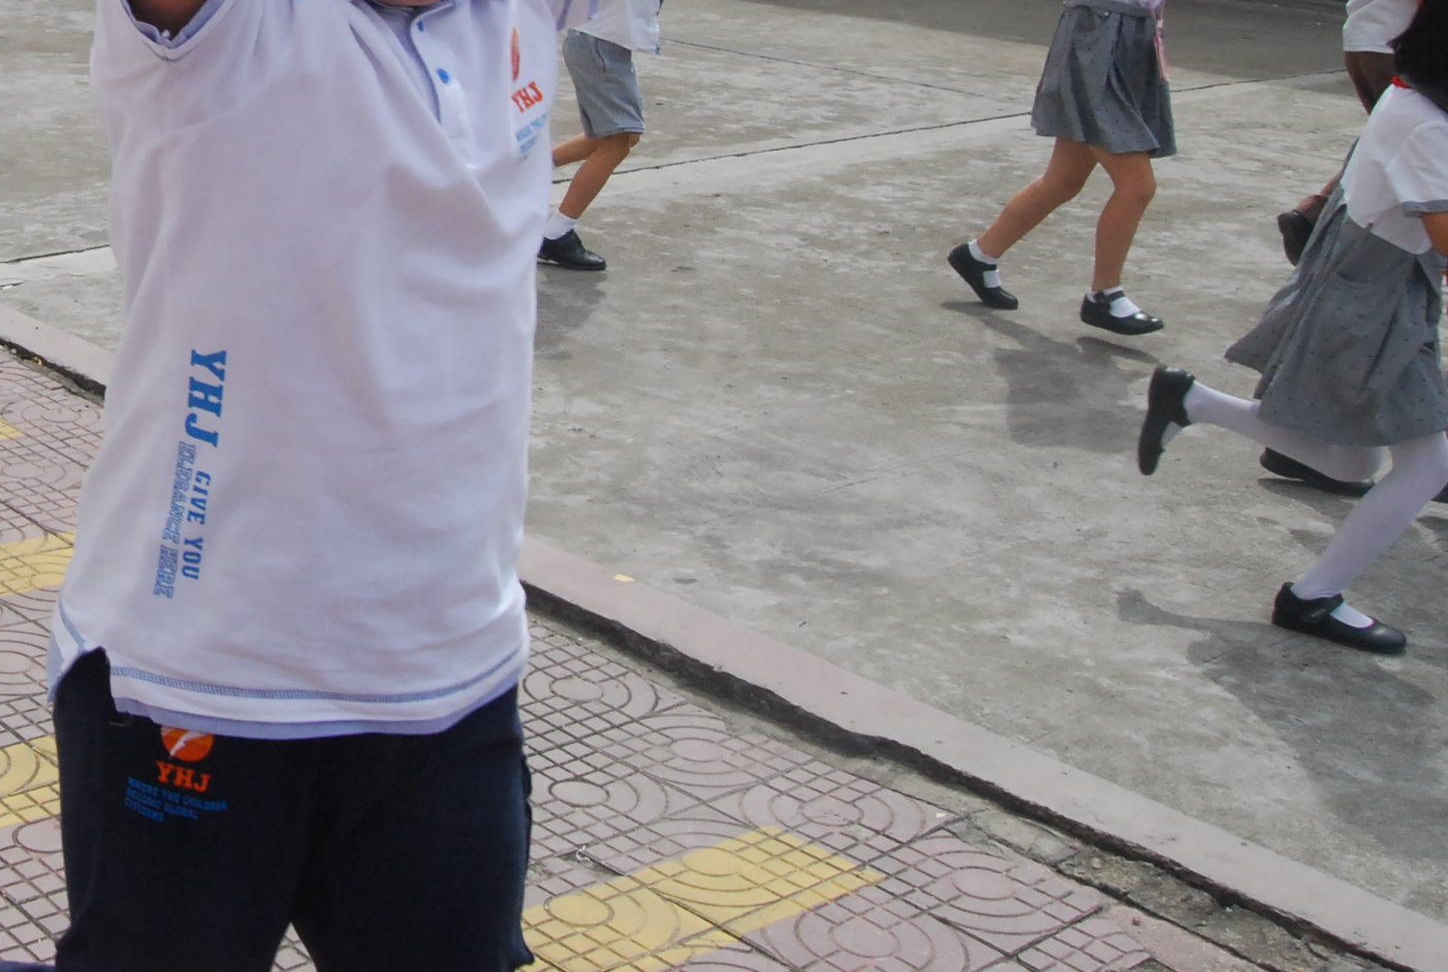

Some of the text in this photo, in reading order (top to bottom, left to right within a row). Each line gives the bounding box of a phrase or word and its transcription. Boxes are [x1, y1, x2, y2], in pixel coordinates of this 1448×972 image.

[511, 81, 544, 114] YHJ
[185, 349, 227, 448] YHJ
[182, 470, 211, 580] GIVE YOU
[155, 759, 212, 792] YHJ
